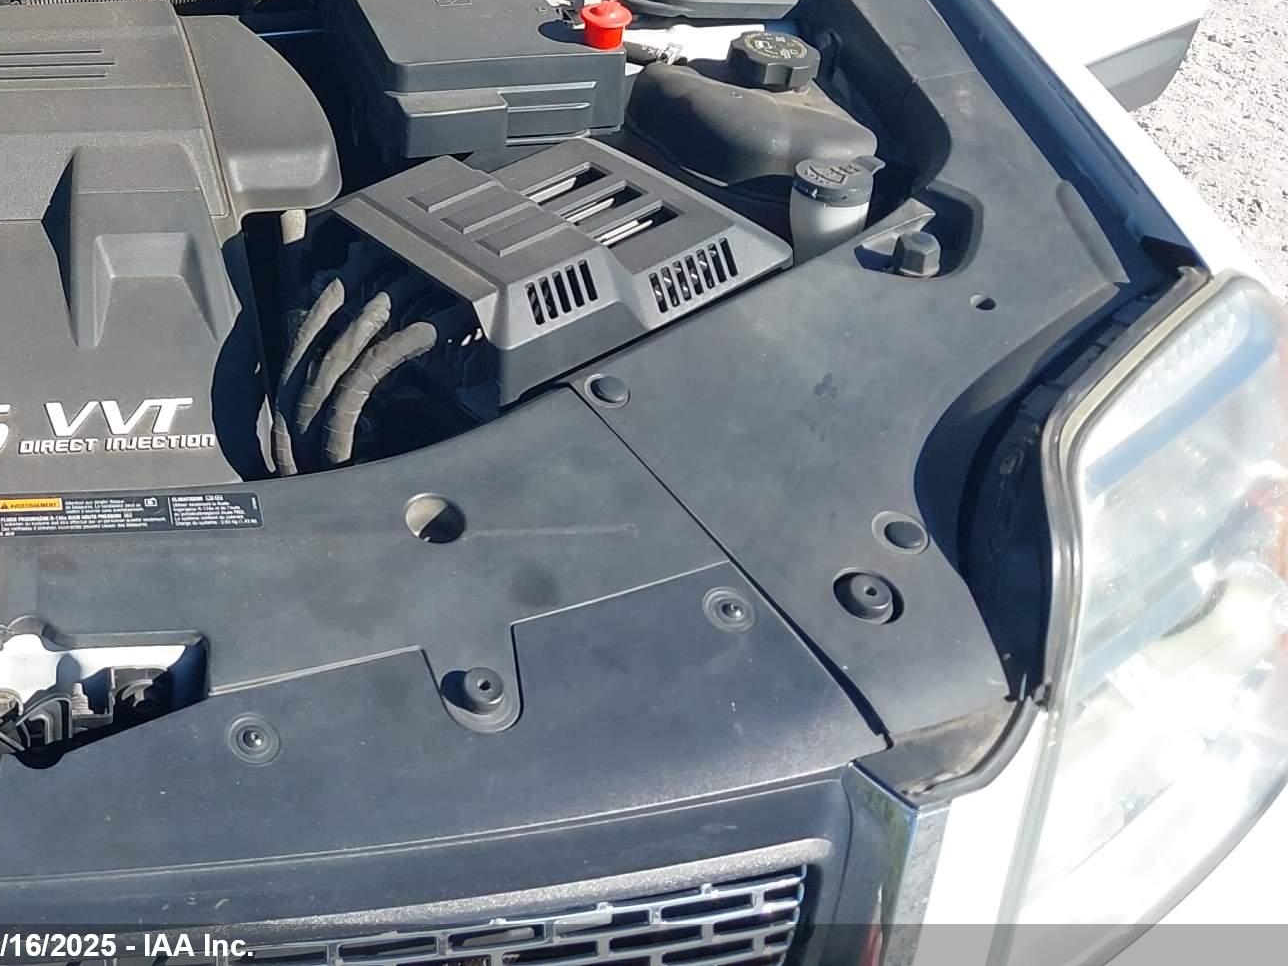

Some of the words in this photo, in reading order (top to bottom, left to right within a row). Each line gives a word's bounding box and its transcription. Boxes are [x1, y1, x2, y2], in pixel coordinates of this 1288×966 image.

[43, 397, 194, 437] VVT
[17, 438, 100, 455] DIRECT
[104, 433, 216, 452] INJECTION
